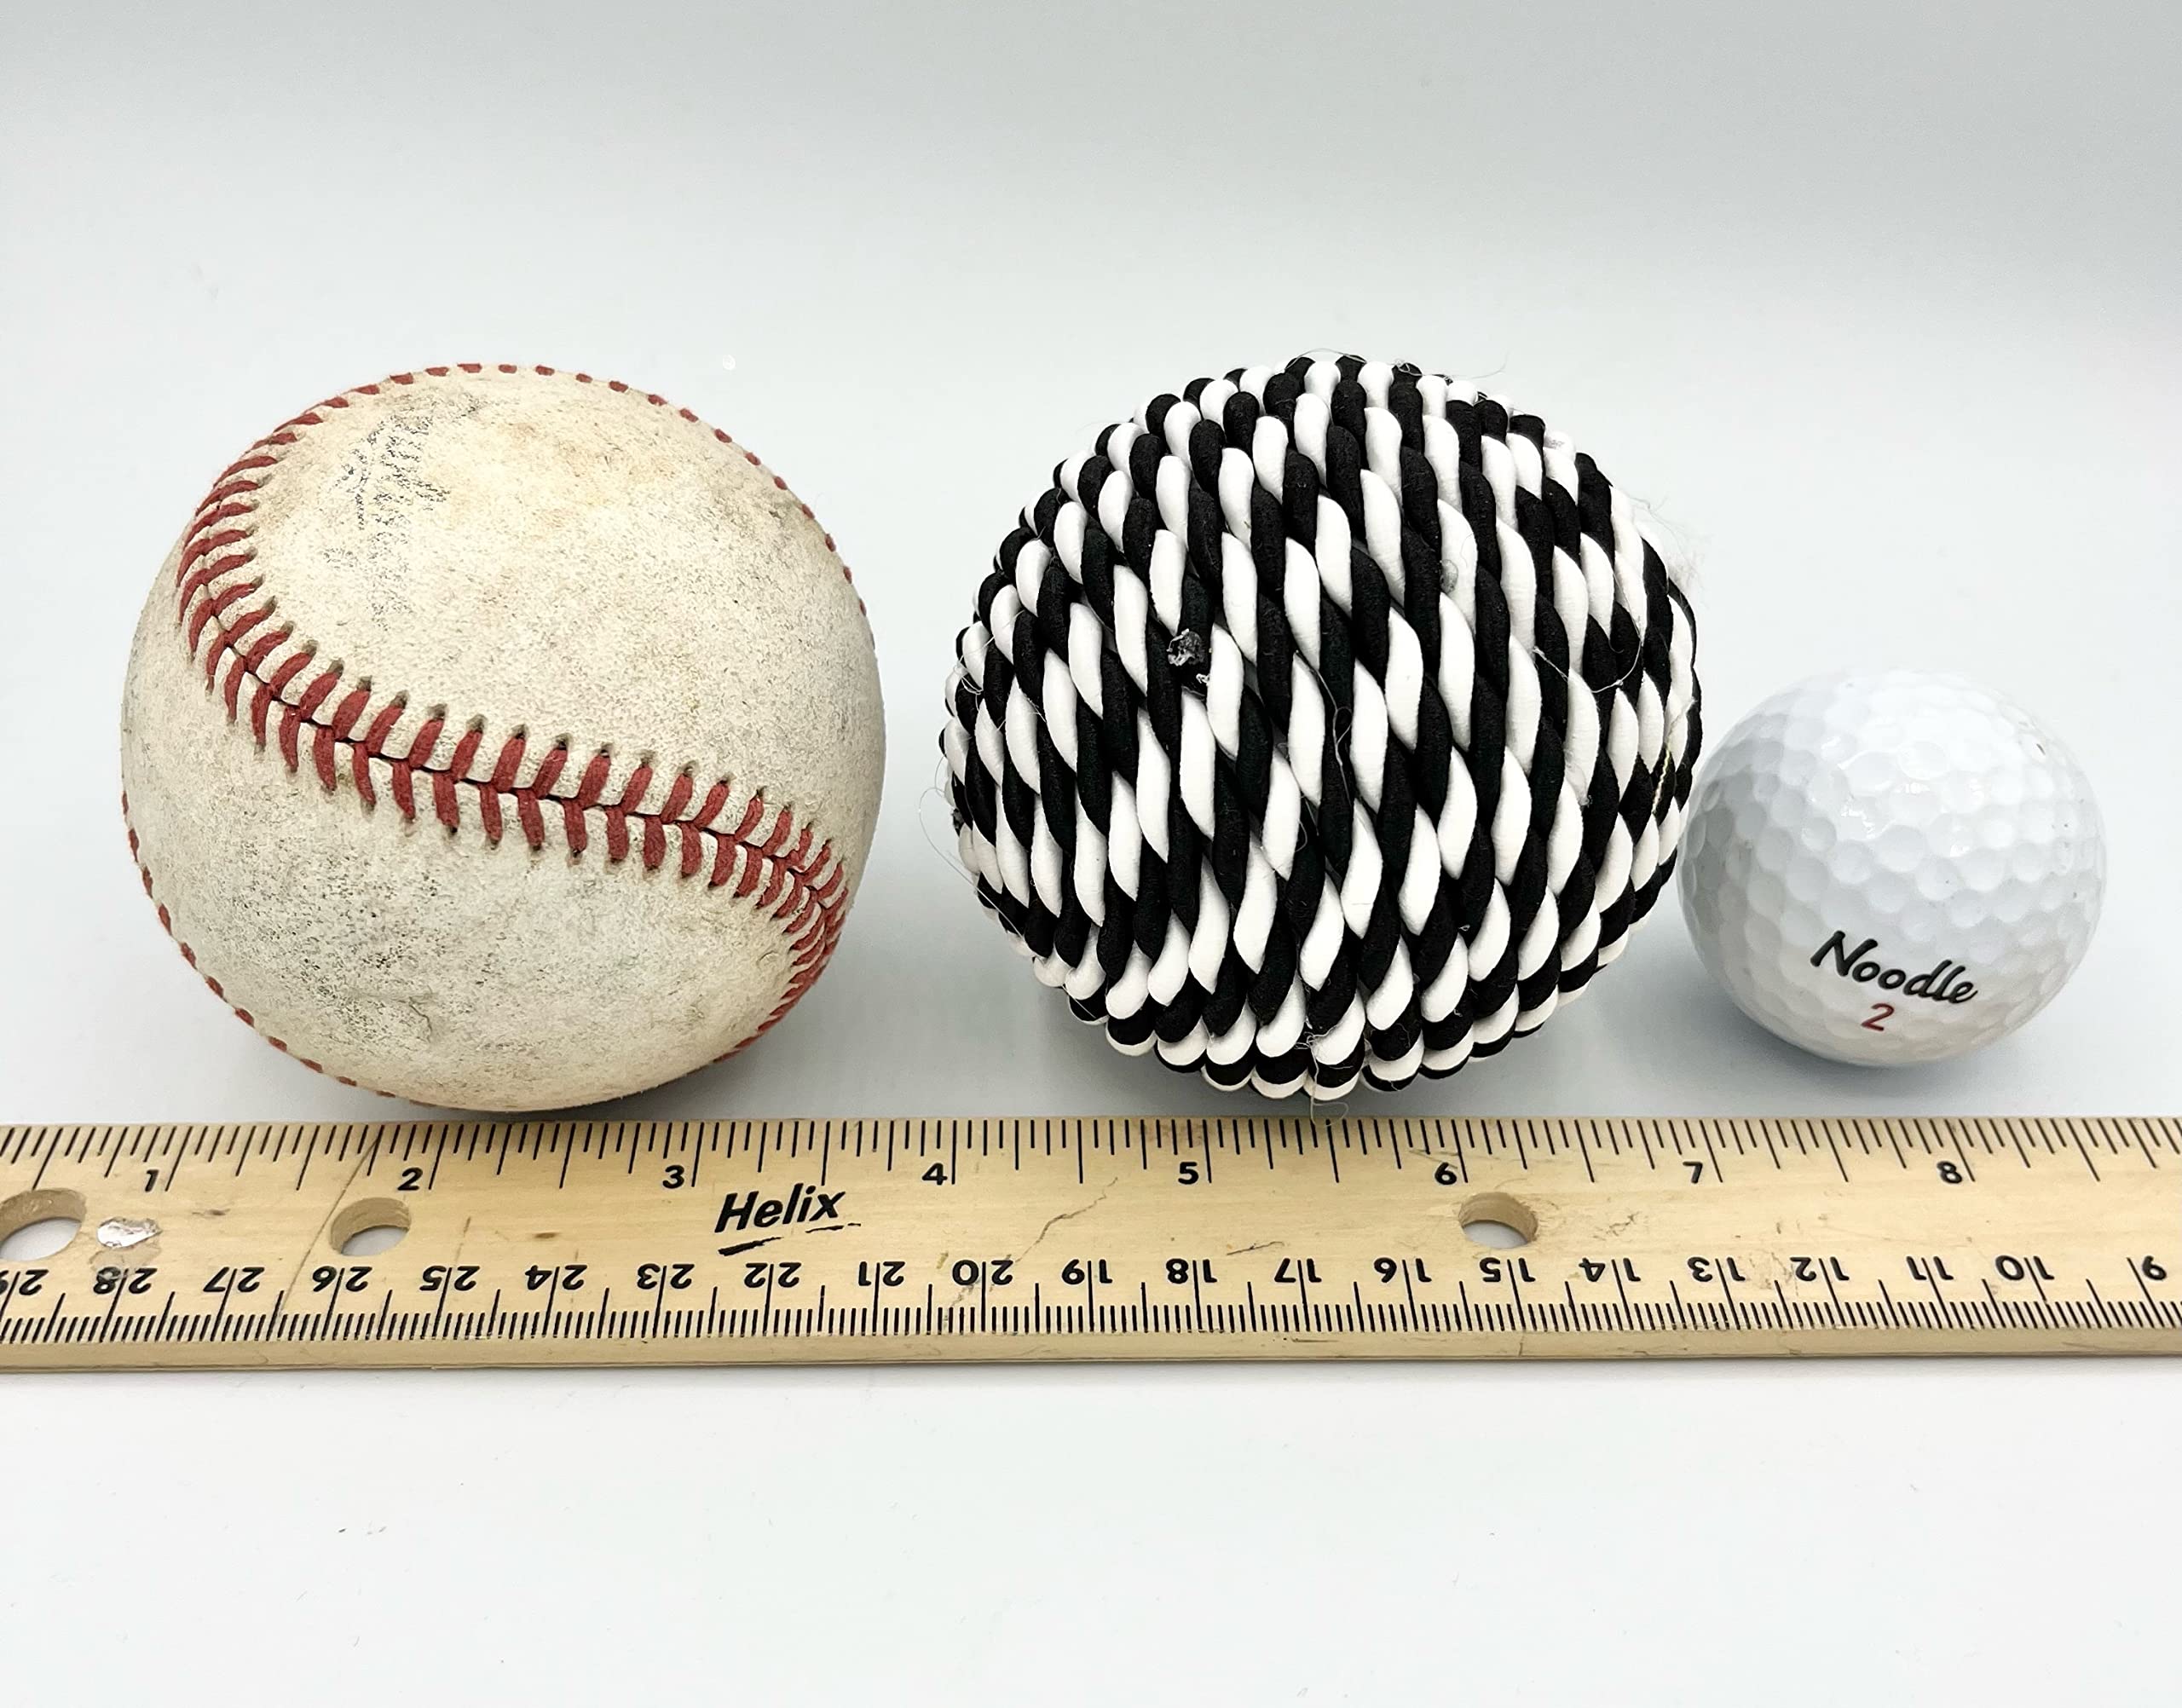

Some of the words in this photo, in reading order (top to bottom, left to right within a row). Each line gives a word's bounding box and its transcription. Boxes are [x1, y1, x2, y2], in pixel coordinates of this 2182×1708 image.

[1810, 930, 1978, 1004] Noodle
[1860, 1002, 1895, 1032] 2
[144, 1169, 159, 1192] 1
[396, 1167, 424, 1192] 2
[661, 1164, 685, 1190] 3
[921, 1162, 948, 1186] 4
[1177, 1161, 1200, 1186] 5
[1434, 1162, 1458, 1186] 6
[1683, 1161, 1705, 1185] 7
[1937, 1161, 1963, 1185] 8
[714, 1182, 846, 1233] Helix
[93, 1267, 158, 1295] 28
[202, 1267, 265, 1293] 27
[312, 1266, 372, 1293] 26
[419, 1265, 481, 1291] 25
[524, 1264, 588, 1291] 24
[637, 1263, 695, 1290] 23
[743, 1261, 802, 1289] 22
[857, 1261, 906, 1287] 21
[952, 1259, 1013, 1287] 20
[1061, 1259, 1113, 1285] 19
[1165, 1258, 1218, 1284] 18
[1273, 1257, 1322, 1284] 17
[1373, 1257, 1432, 1284] 16
[1479, 1257, 1536, 1283] 15
[1579, 1257, 1642, 1283] 14
[1687, 1256, 1746, 1283] 13
[1790, 1256, 1850, 1282] 12
[1906, 1255, 1954, 1281] 11
[1995, 1255, 2055, 1281] 10
[2142, 1255, 2168, 1281] 9
